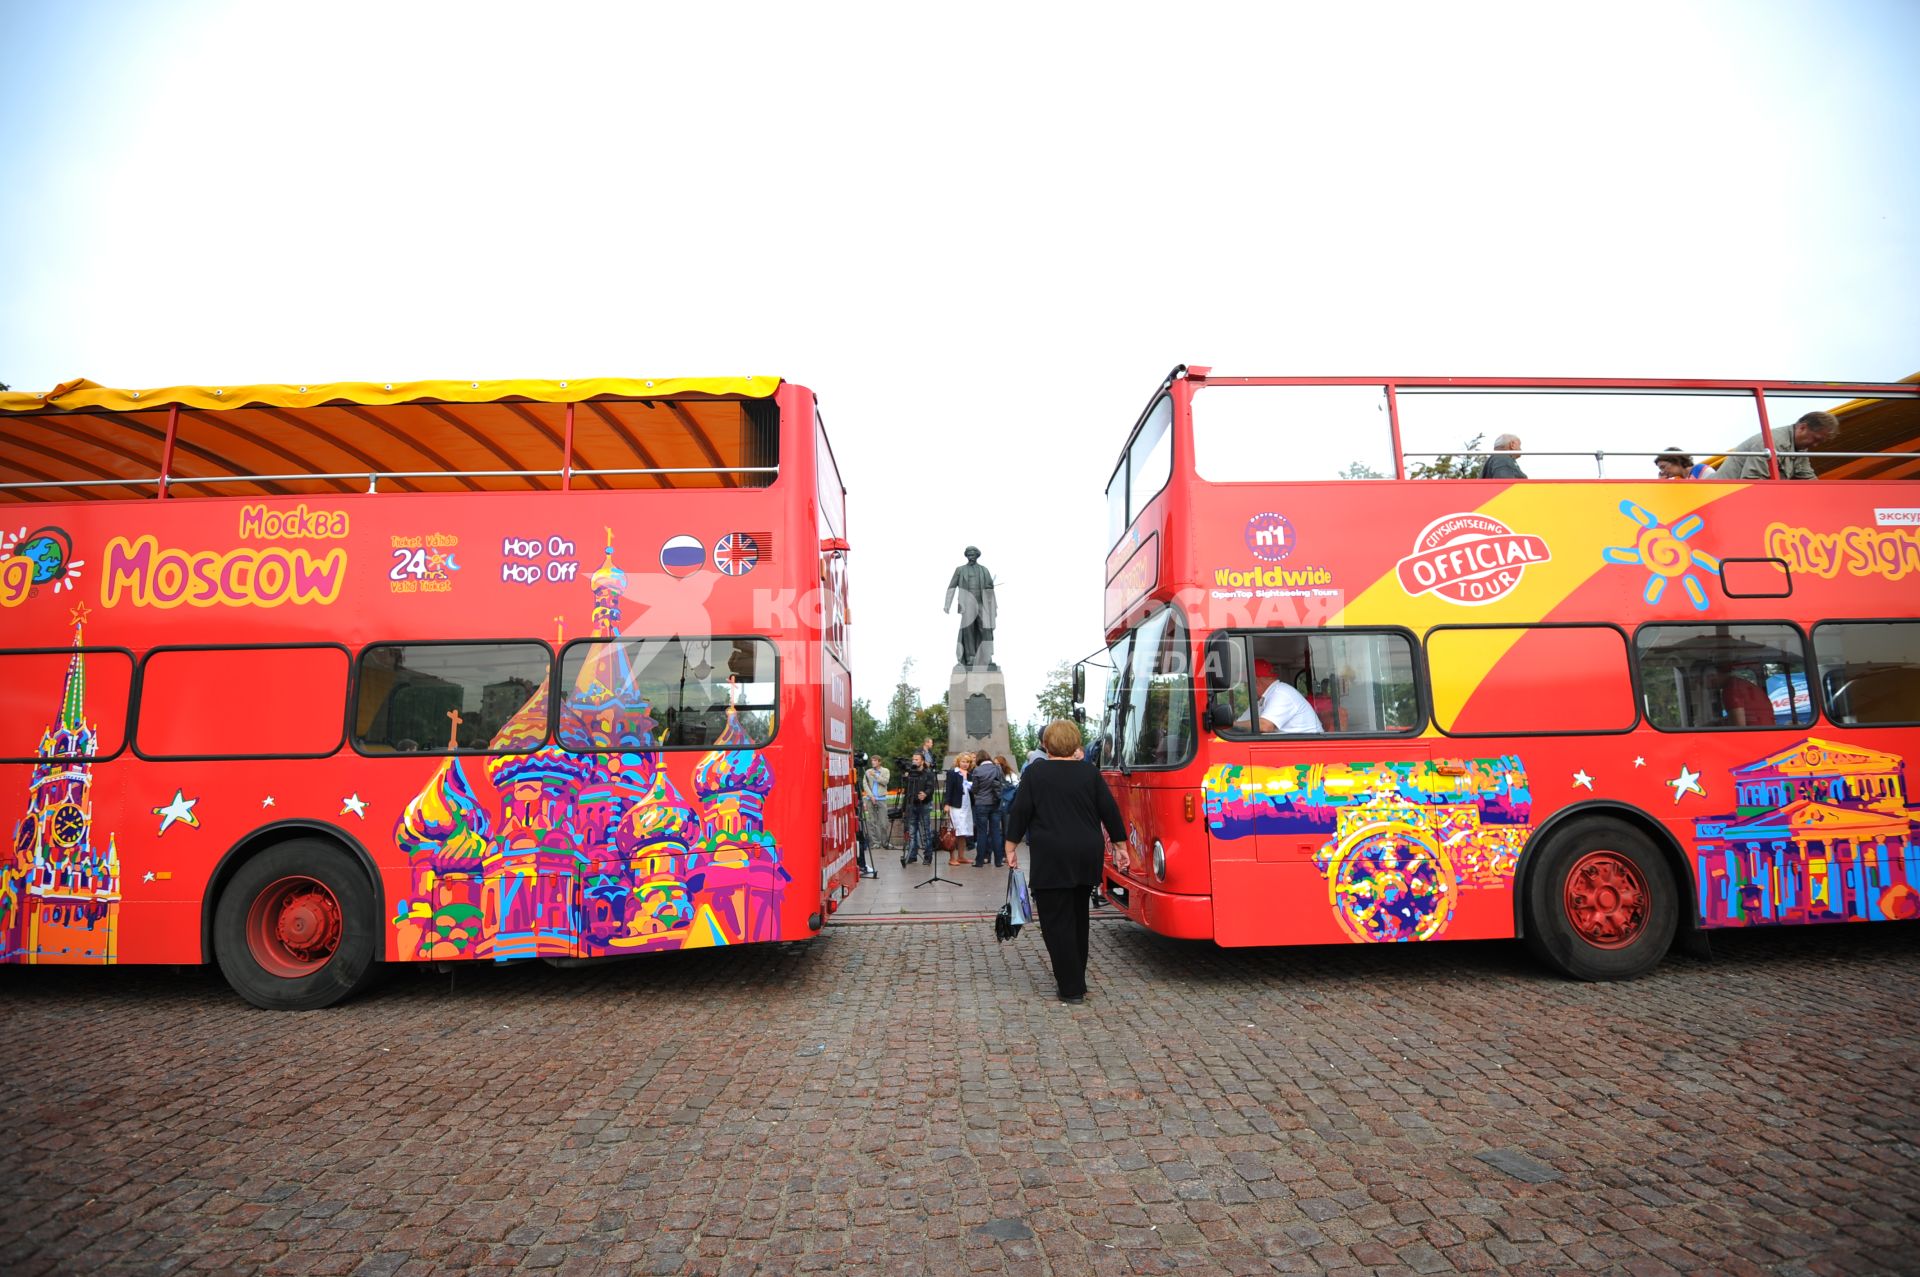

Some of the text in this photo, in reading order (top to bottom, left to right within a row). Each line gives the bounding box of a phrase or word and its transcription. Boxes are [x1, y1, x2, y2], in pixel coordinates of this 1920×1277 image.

[239, 504, 349, 539] Москва
[1426, 518, 1503, 548] CITYSIGHTSEEING
[503, 535, 576, 560] Hop On
[501, 560, 579, 586] Hop Off
[1213, 565, 1332, 588] Worldwide
[1412, 538, 1542, 587] OFFICIAL
[1458, 571, 1516, 599] TOUR
